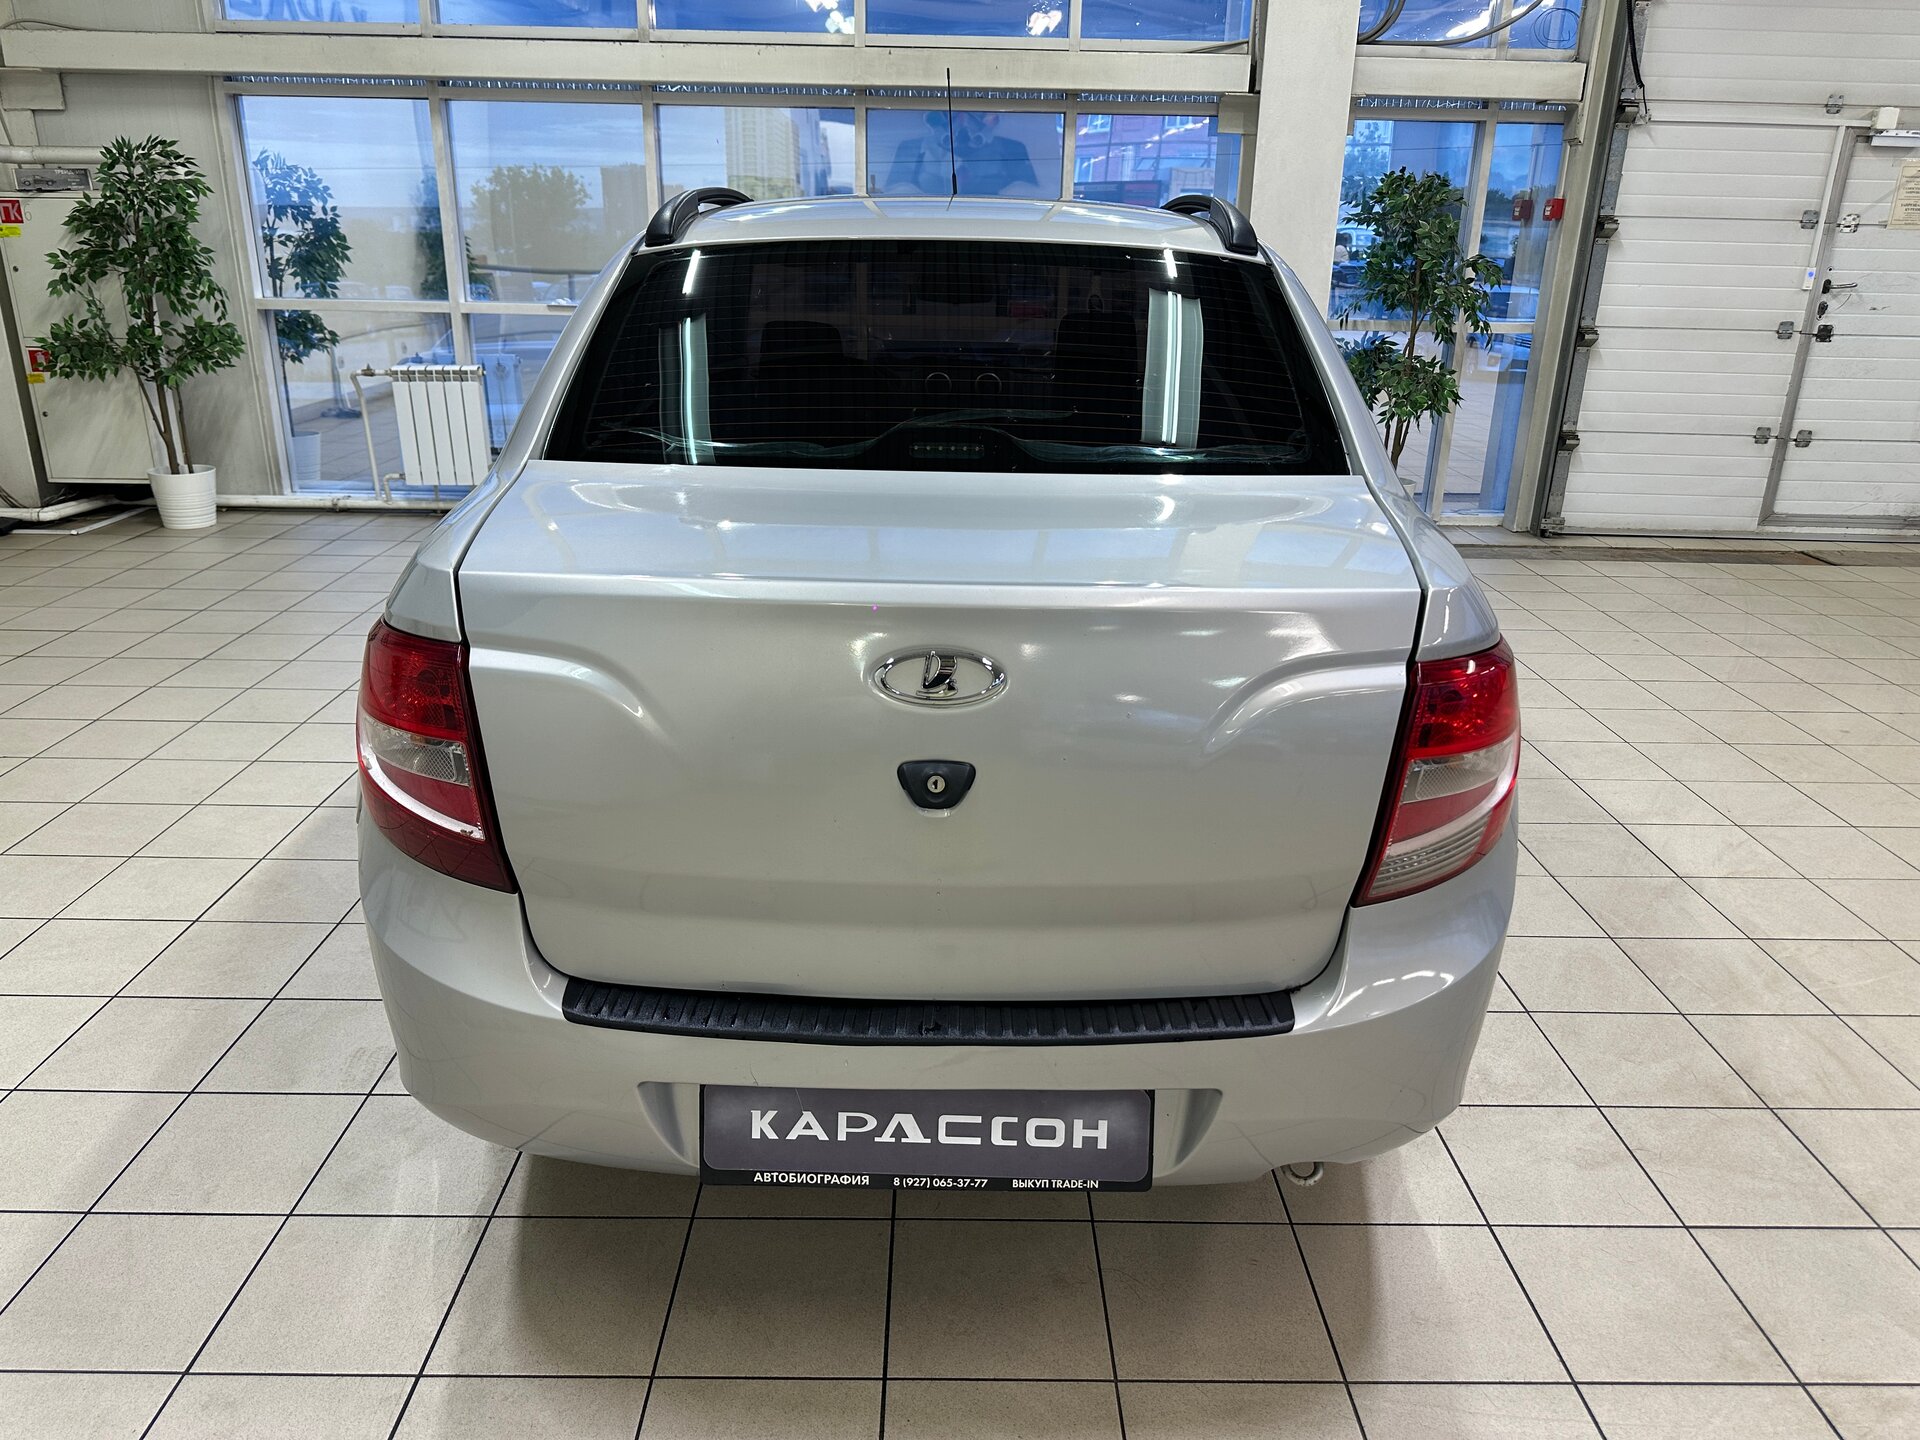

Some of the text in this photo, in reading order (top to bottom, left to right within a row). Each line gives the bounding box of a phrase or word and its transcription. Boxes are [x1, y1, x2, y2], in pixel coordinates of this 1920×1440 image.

[750, 1109, 1108, 1150] КАРАССОН
[753, 1172, 1099, 1190] АВТОБИОГРАФИЯ 8 (927) 065-37-77 ВЫКУП TRADE-IN
